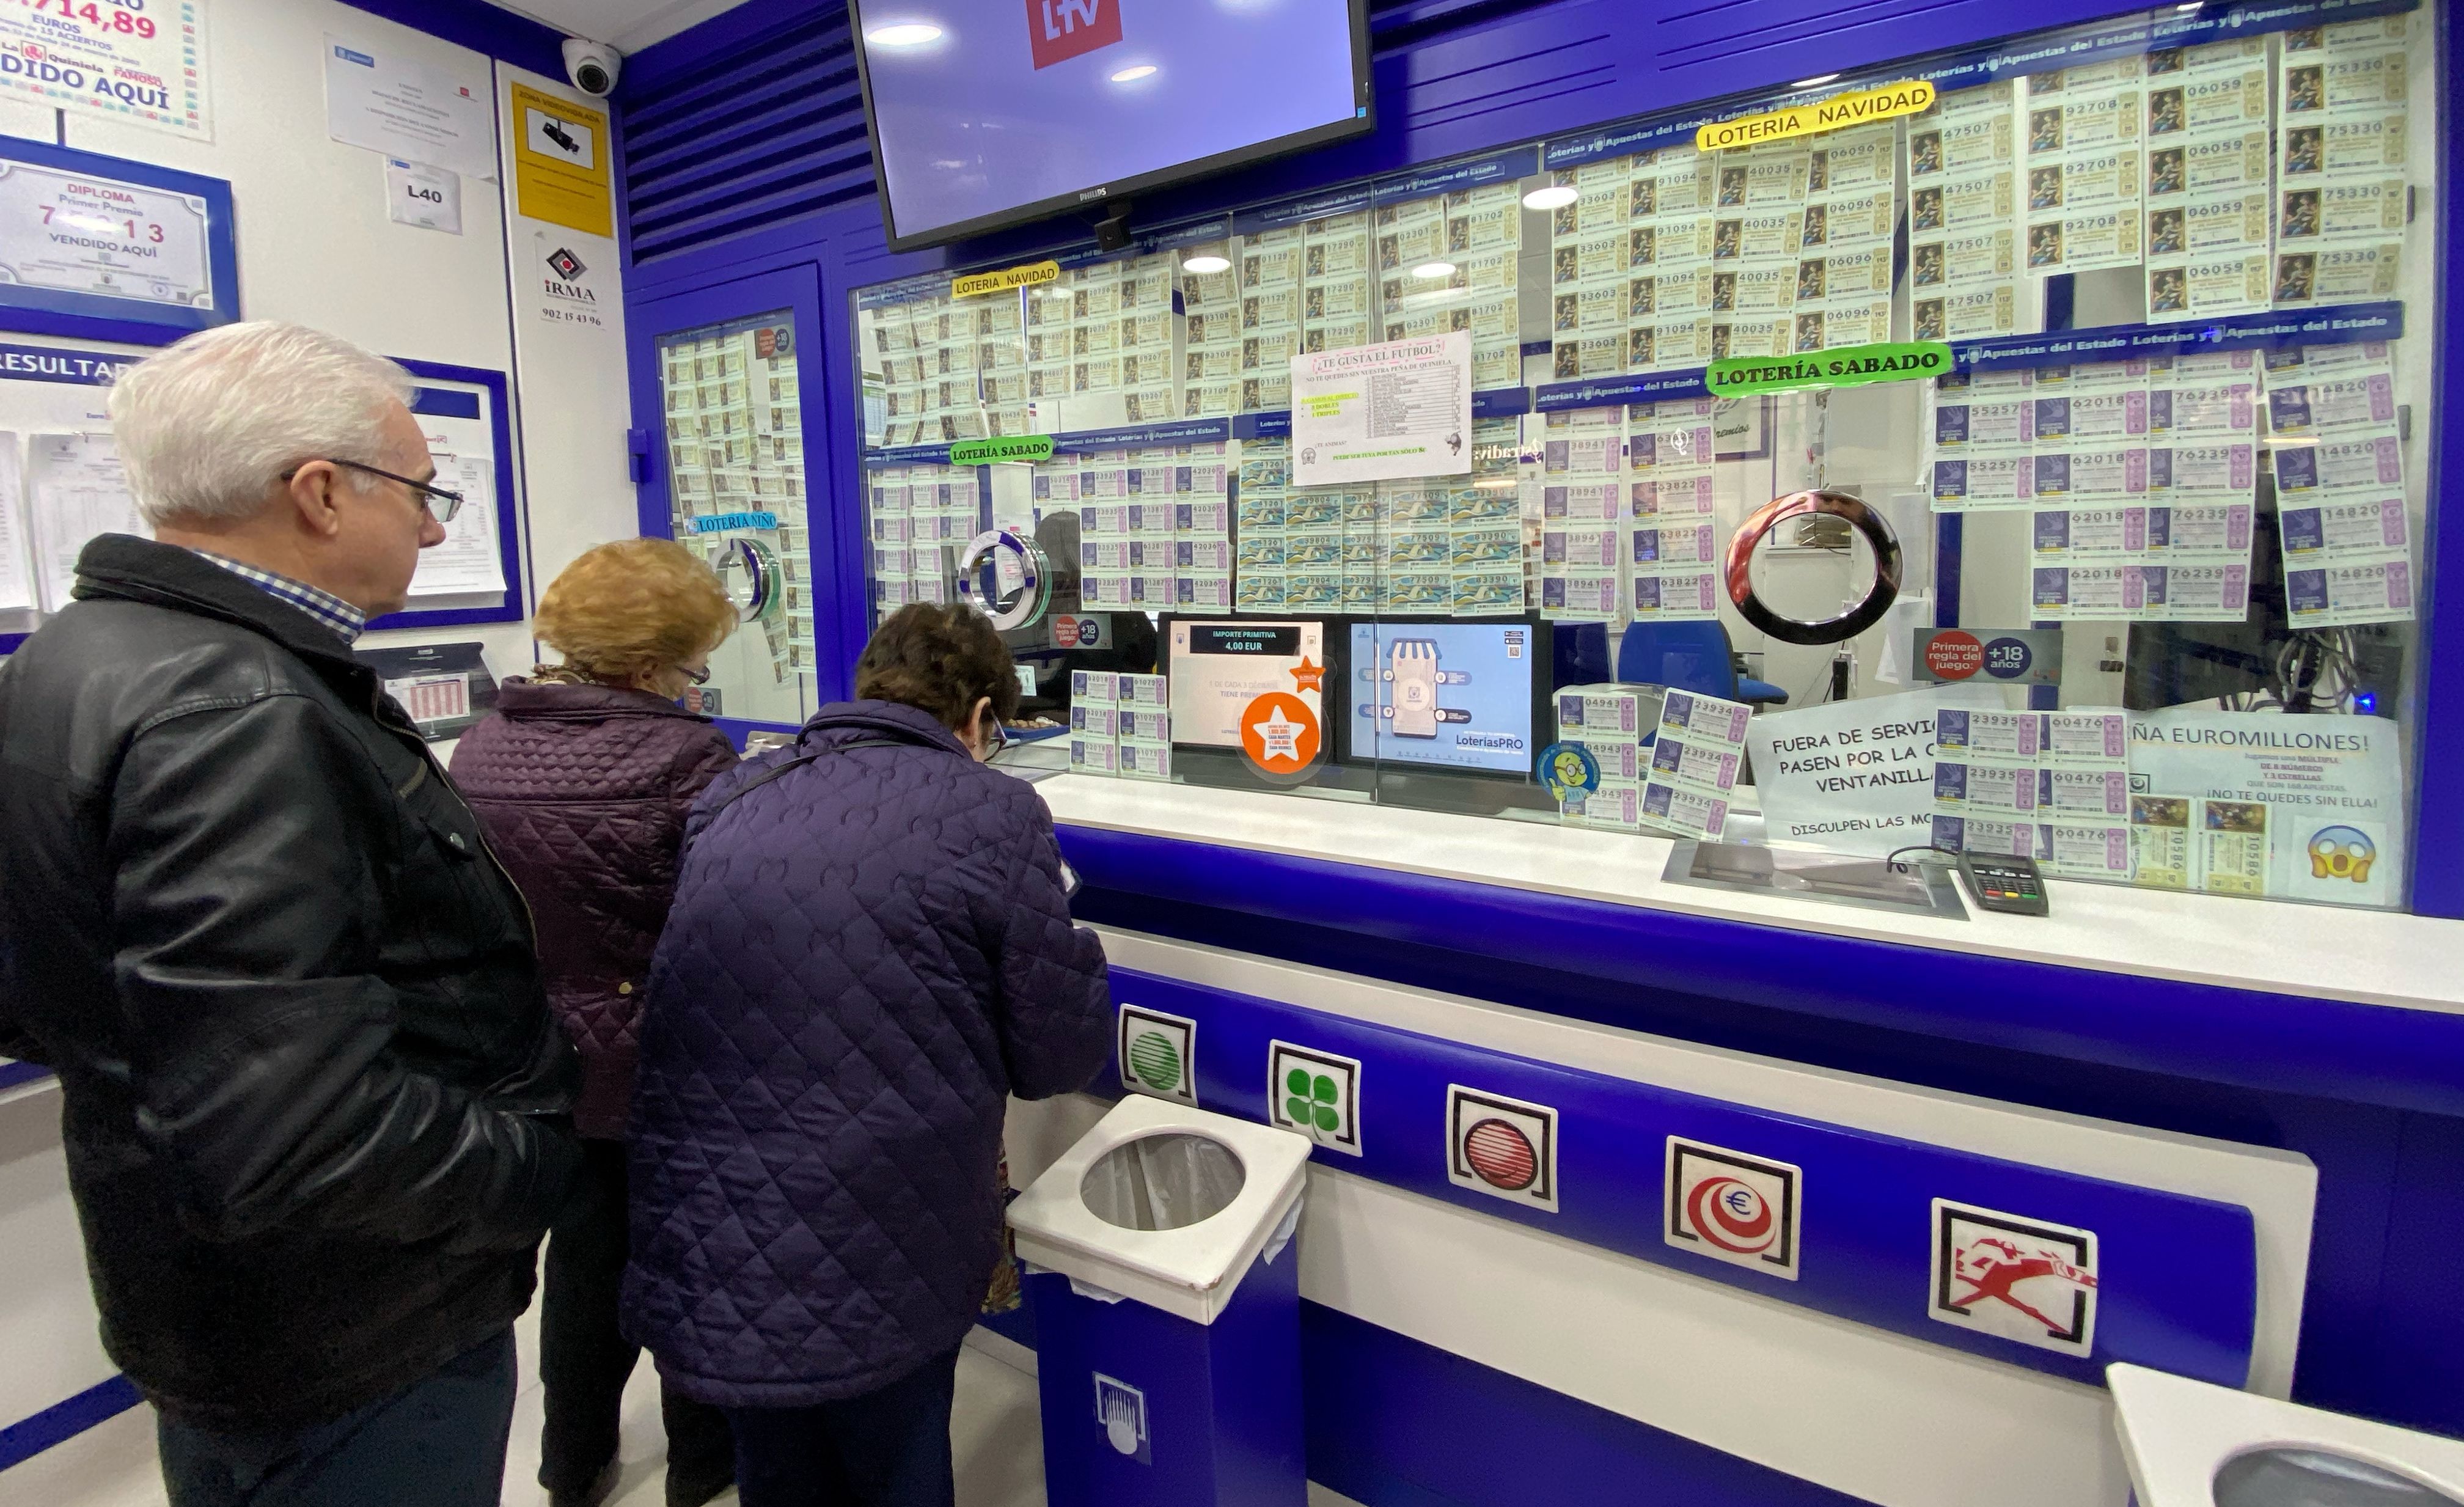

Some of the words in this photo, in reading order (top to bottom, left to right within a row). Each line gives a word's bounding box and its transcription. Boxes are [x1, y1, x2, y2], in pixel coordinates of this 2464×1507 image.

[32, 13, 81, 34] EUROS
[57, 31, 112, 51] ACIERTOS
[48, 53, 104, 73] Quiniela
[1919, 65, 1974, 81] Loterías
[2001, 46, 2066, 65] Apuestas
[2070, 40, 2092, 52] del
[2096, 31, 2146, 46] Estado
[2327, 61, 2382, 75] 75330
[95, 77, 170, 109] AQUÍ
[2188, 79, 2241, 97] 06059
[2066, 100, 2118, 116] 92708
[1706, 115, 1800, 147] LOTERIA
[1819, 88, 1927, 124] NAVIDAD
[1605, 130, 1652, 147] Apuestas
[1656, 125, 1673, 136] del
[1944, 122, 1990, 139] 47507
[1830, 144, 1875, 159] 06096
[1750, 164, 1791, 175] 40035
[2066, 159, 2117, 174] 92708
[1419, 174, 1454, 186] Apuestas
[1470, 165, 1497, 175] Estado
[1658, 173, 1697, 185] 91094
[67, 183, 134, 204] DIPLOMA
[407, 185, 442, 203] L40
[1080, 188, 1106, 201] PHILIPS
[1946, 180, 1991, 194] 47507
[59, 194, 99, 209] Primer
[103, 202, 144, 217] Premio
[1579, 192, 1615, 206] 33603
[1830, 199, 1873, 213] 06096
[1471, 211, 1503, 223] 81702
[1399, 227, 1429, 241] 02301
[1657, 223, 1696, 235] 91094
[49, 233, 118, 252] VENDIDO
[1327, 240, 1354, 251] 17290
[1261, 253, 1287, 263] 01129
[956, 277, 1000, 294] LOTERIA
[1007, 268, 1055, 285] NAVIDAD
[542, 307, 562, 319] 902
[564, 312, 573, 321] 15
[576, 314, 587, 323] 43
[589, 316, 601, 326] 96
[2133, 332, 2194, 346] Loterías
[2226, 325, 2298, 338] Apuestas
[2303, 320, 2327, 331] del
[2332, 316, 2387, 329] Estado
[1982, 346, 2046, 359] Apuestas
[2050, 342, 2072, 352] del
[2077, 338, 2126, 350] Estado
[1317, 359, 1335, 371] ¿TE
[1338, 354, 1372, 367] GUSTA
[1375, 351, 1388, 361] EL
[1392, 343, 1441, 360] FUTBOL?
[1324, 372, 1348, 381] QUEDES
[1361, 368, 1389, 376] NUESTRA
[1419, 360, 1452, 369] QUINIELA
[1715, 361, 1823, 386] LOTERÍA
[1828, 350, 1940, 376] SABADO
[1594, 385, 1642, 397] Apuestas
[1663, 378, 1700, 389] Estado
[2072, 396, 2125, 408] 62018
[2176, 389, 2230, 402] 76239
[1971, 405, 2019, 416] 55257
[953, 445, 999, 461] LOTERÍA
[1002, 443, 1049, 457] SABADO
[1571, 441, 1605, 450] 38941
[2323, 441, 2374, 456] 14820
[1657, 481, 1696, 490] 63822
[699, 515, 749, 532] LOTERIA
[751, 512, 776, 527] NIÑO
[2072, 512, 2124, 522] 62018
[1410, 533, 1440, 542] 77509
[1473, 532, 1508, 541] 83390
[1081, 625, 1096, 634] +18
[1243, 631, 1276, 639] PRIMITIVA
[1225, 642, 1242, 652] 4,00
[1245, 642, 1262, 651] EUR
[1932, 642, 1979, 651] Primera
[1989, 647, 2023, 661] +18
[1962, 652, 1981, 661] del
[1990, 659, 2020, 669] años
[1935, 661, 1973, 670] juego:
[1585, 698, 1620, 708] 04943
[1695, 700, 1732, 714] 23934
[1971, 714, 2018, 726] 23935
[2052, 718, 2103, 727] 60476
[1772, 734, 1831, 755] FUERA
[1839, 731, 1862, 745] DE
[2173, 728, 2369, 752] EUROMILLONES!
[1780, 756, 1839, 775] PASEN
[1847, 751, 1884, 767] POR
[1893, 747, 1917, 761] LA
[2238, 791, 2253, 799] TE
[2256, 791, 2311, 804] QUEDES
[2316, 795, 2337, 805] SIN
[2342, 798, 2378, 808] ELLA!
[1791, 819, 1871, 837] DISCULPEN
[1876, 816, 1904, 828] LAS
[2170, 831, 2184, 870] 10586
